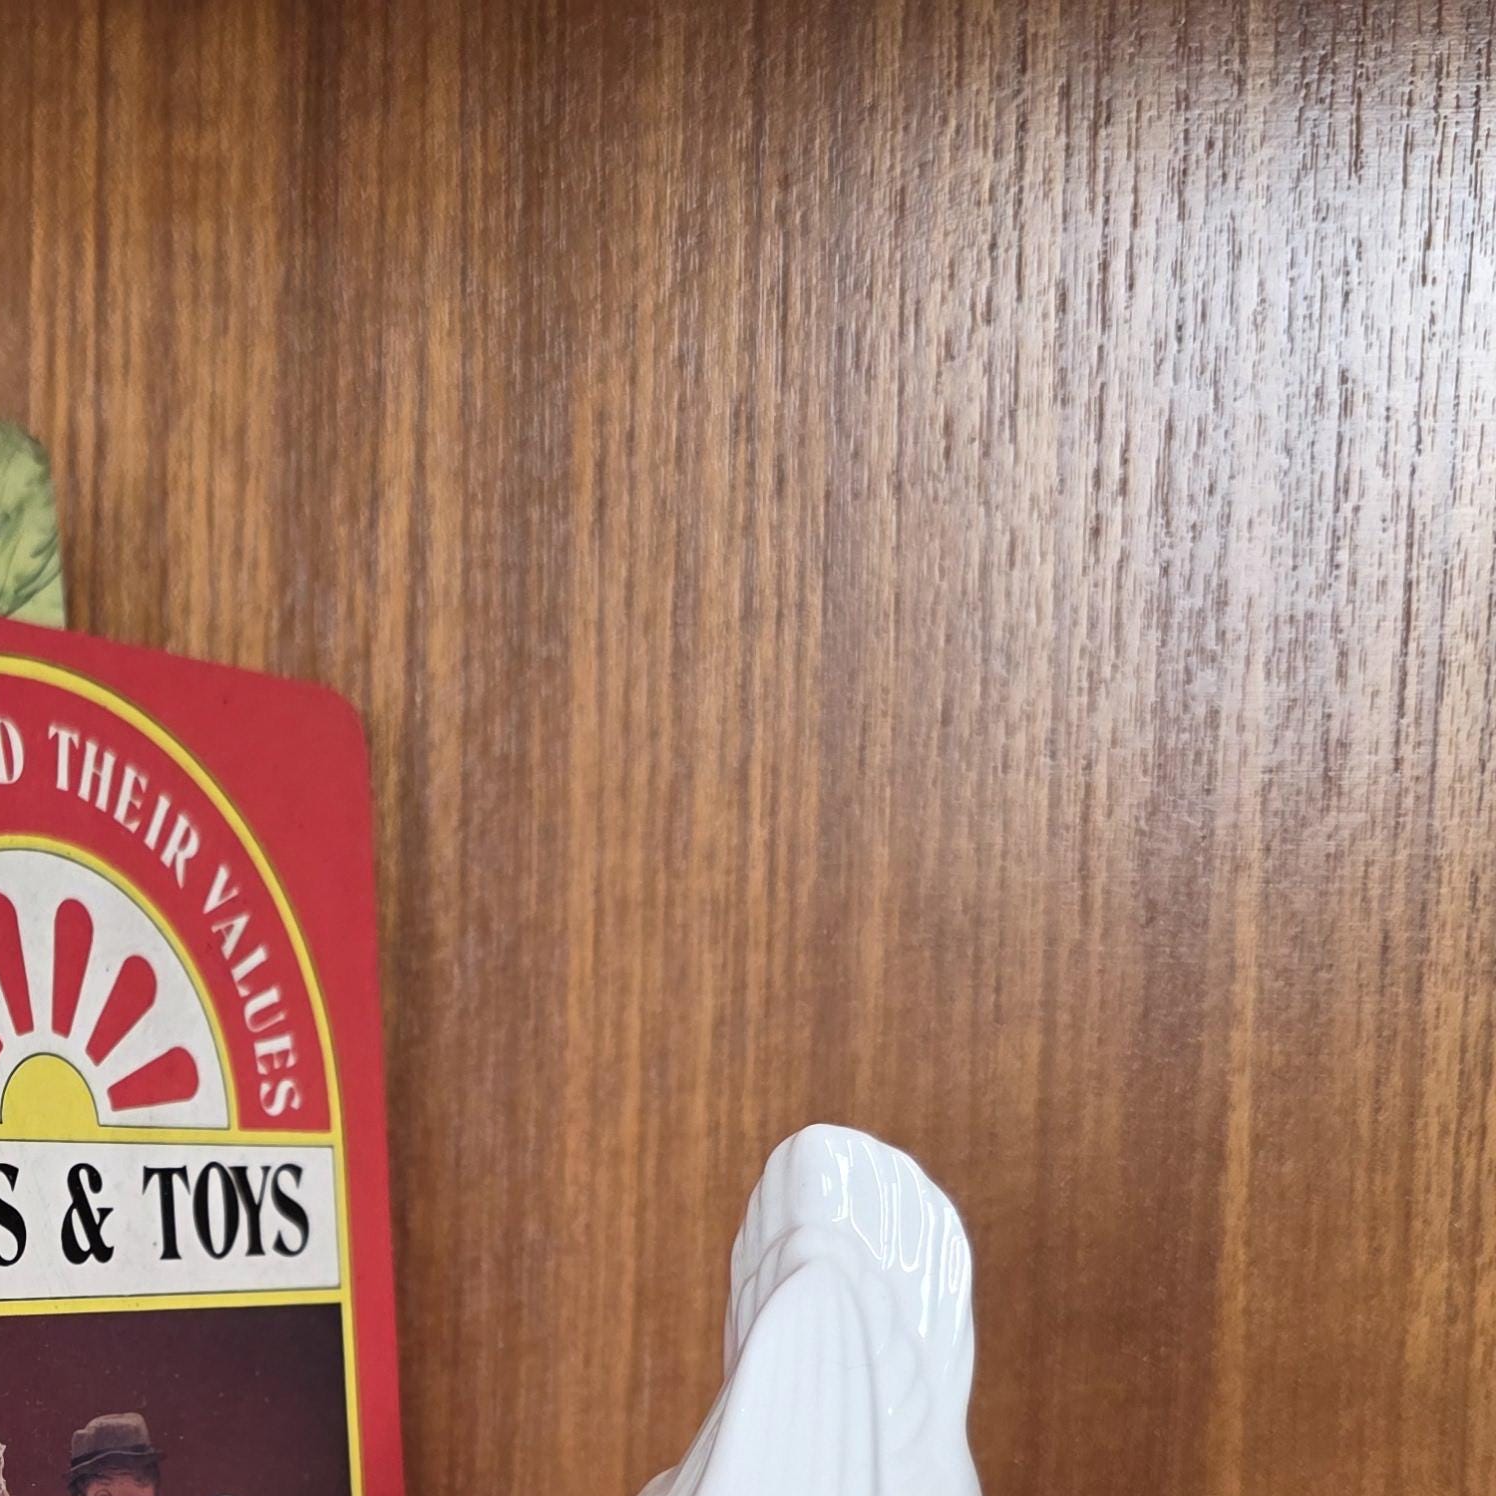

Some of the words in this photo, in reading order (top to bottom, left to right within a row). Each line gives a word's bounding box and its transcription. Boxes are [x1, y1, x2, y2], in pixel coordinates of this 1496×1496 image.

[48, 725, 200, 888] THEIR
[203, 864, 301, 1117] VALUES
[61, 1163, 115, 1265] &
[142, 1162, 308, 1260] TOYS
